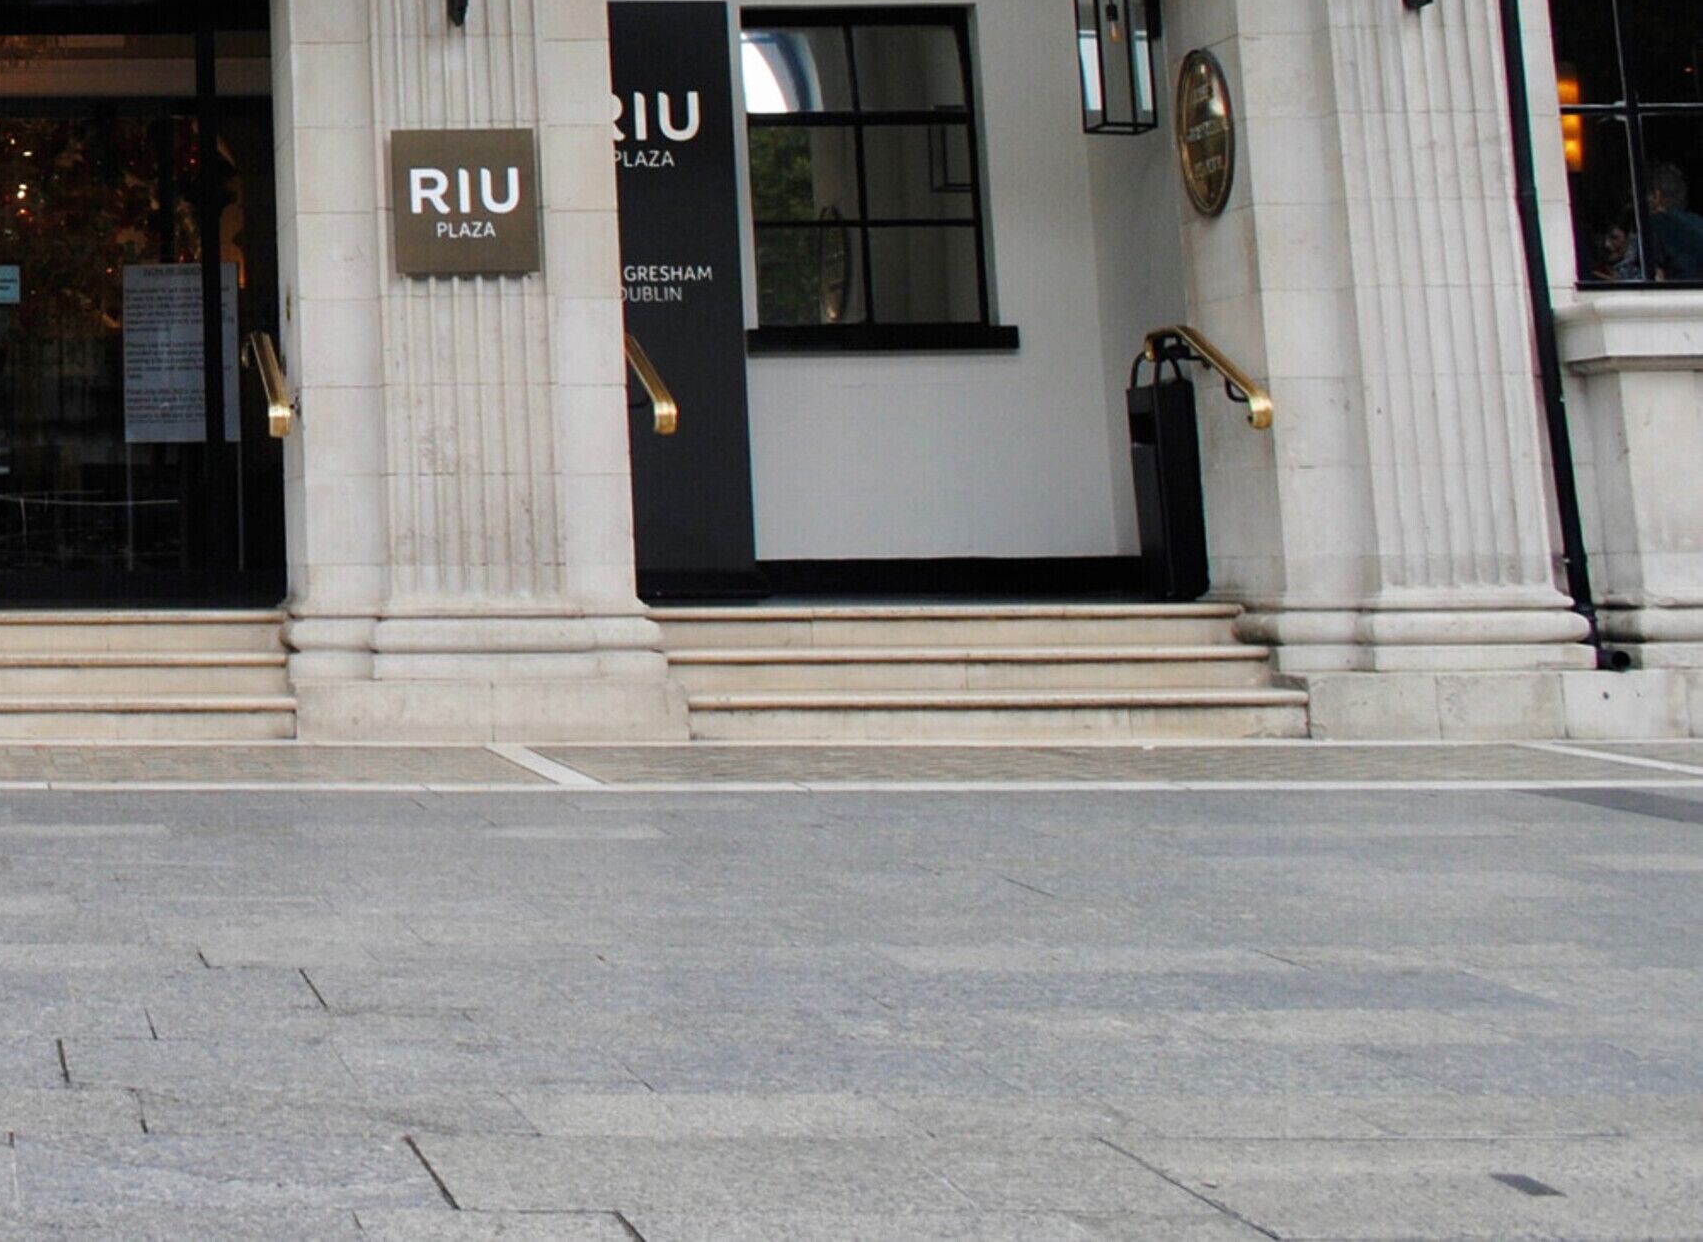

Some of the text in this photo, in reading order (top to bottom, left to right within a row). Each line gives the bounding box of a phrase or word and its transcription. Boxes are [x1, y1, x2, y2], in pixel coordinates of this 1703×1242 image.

[409, 166, 521, 214] RIU
[436, 221, 497, 238] PLAZA
[623, 265, 713, 282] GRESHAM
